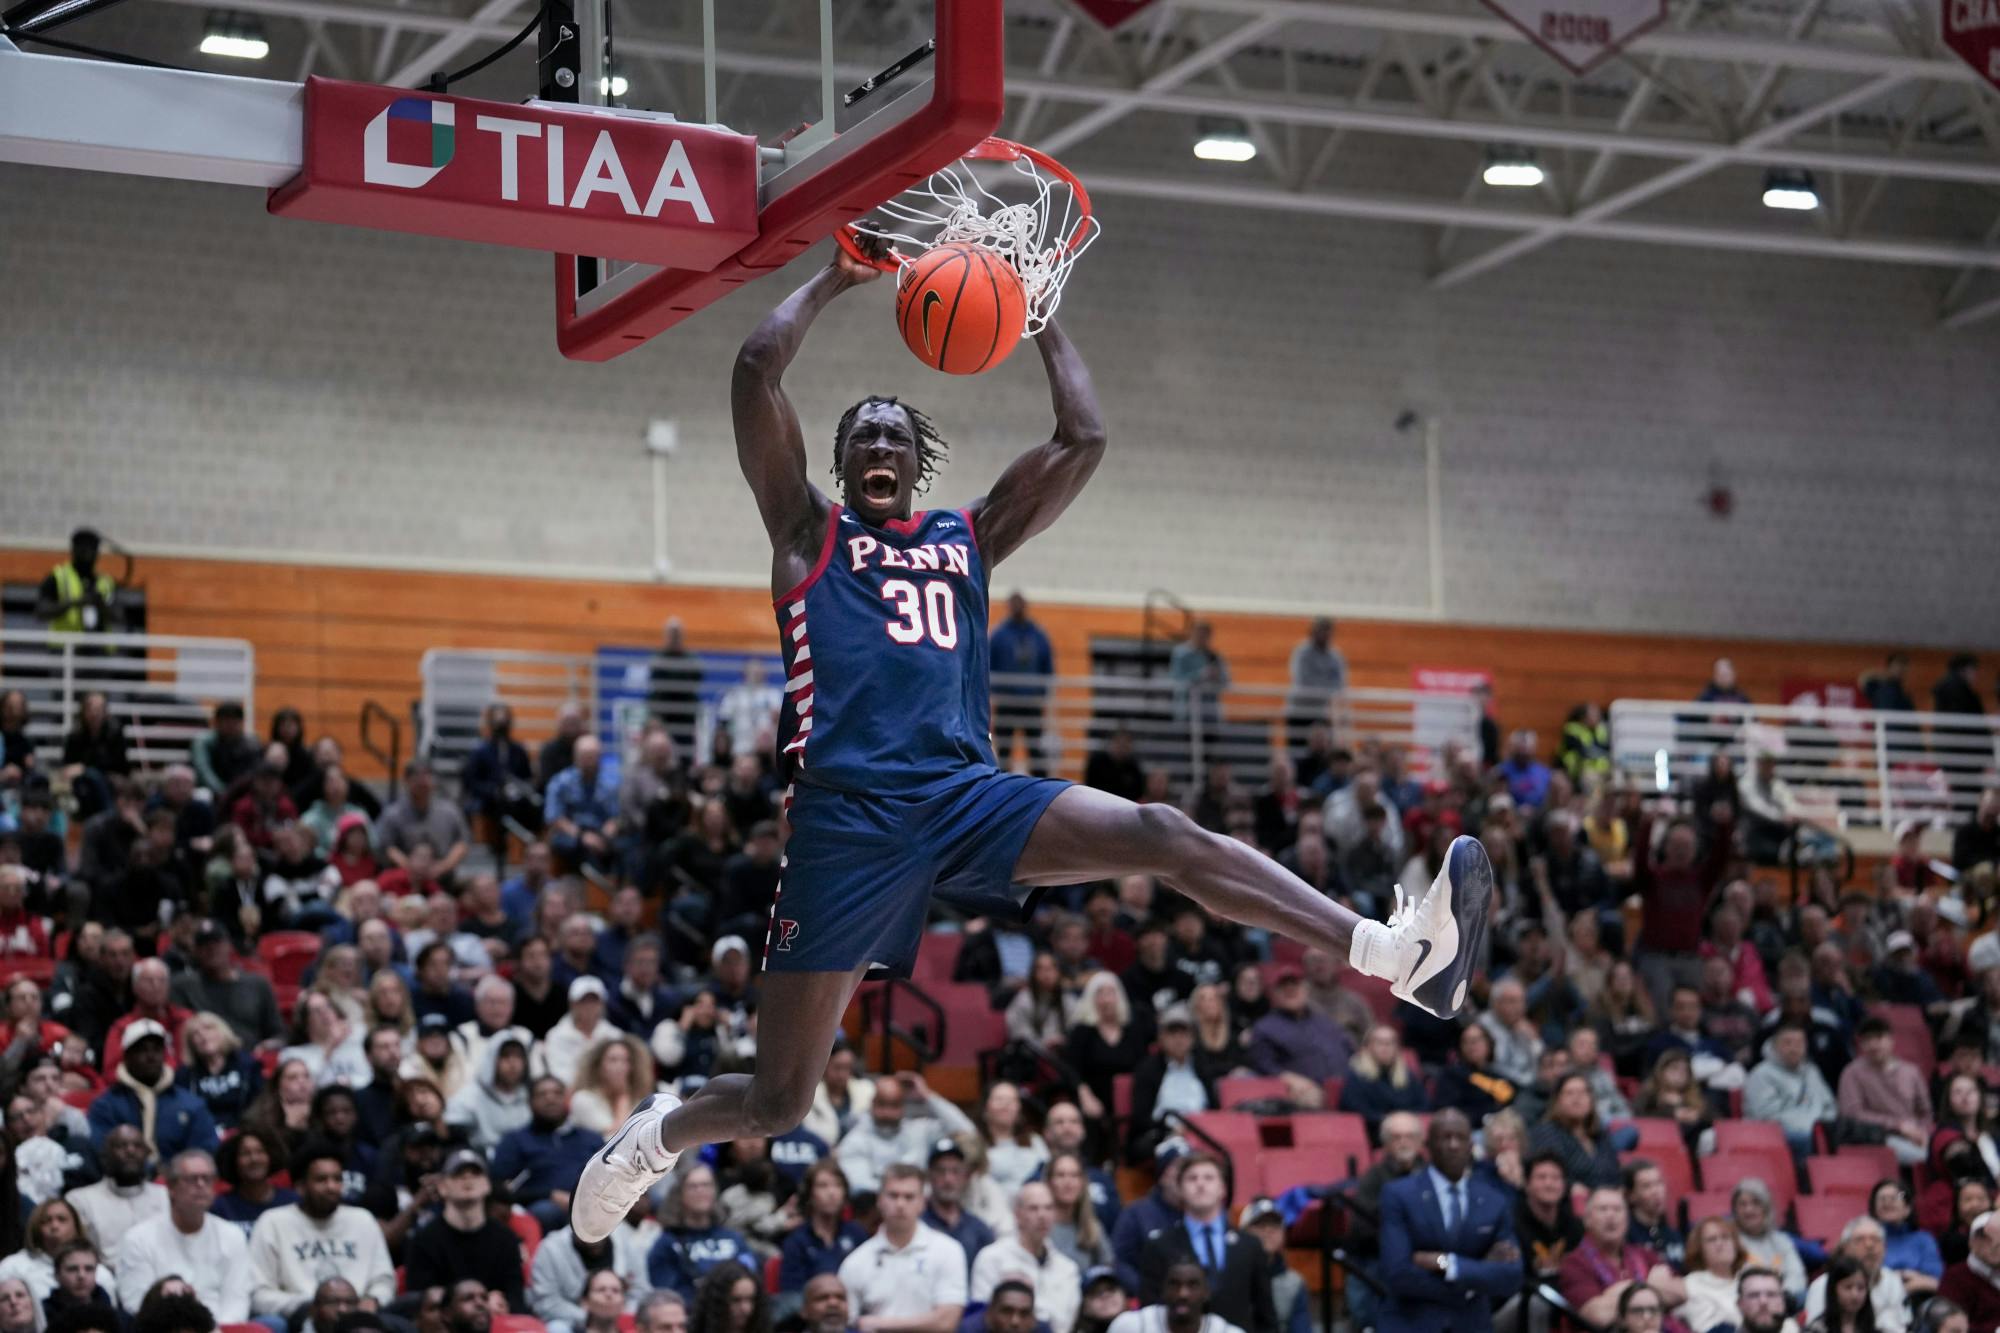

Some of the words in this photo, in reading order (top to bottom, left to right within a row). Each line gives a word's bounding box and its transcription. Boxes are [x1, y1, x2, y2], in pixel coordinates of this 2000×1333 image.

[476, 114, 715, 224] TIAA
[848, 536, 969, 577] PENN
[881, 579, 958, 650] 30
[777, 919, 800, 951] P
